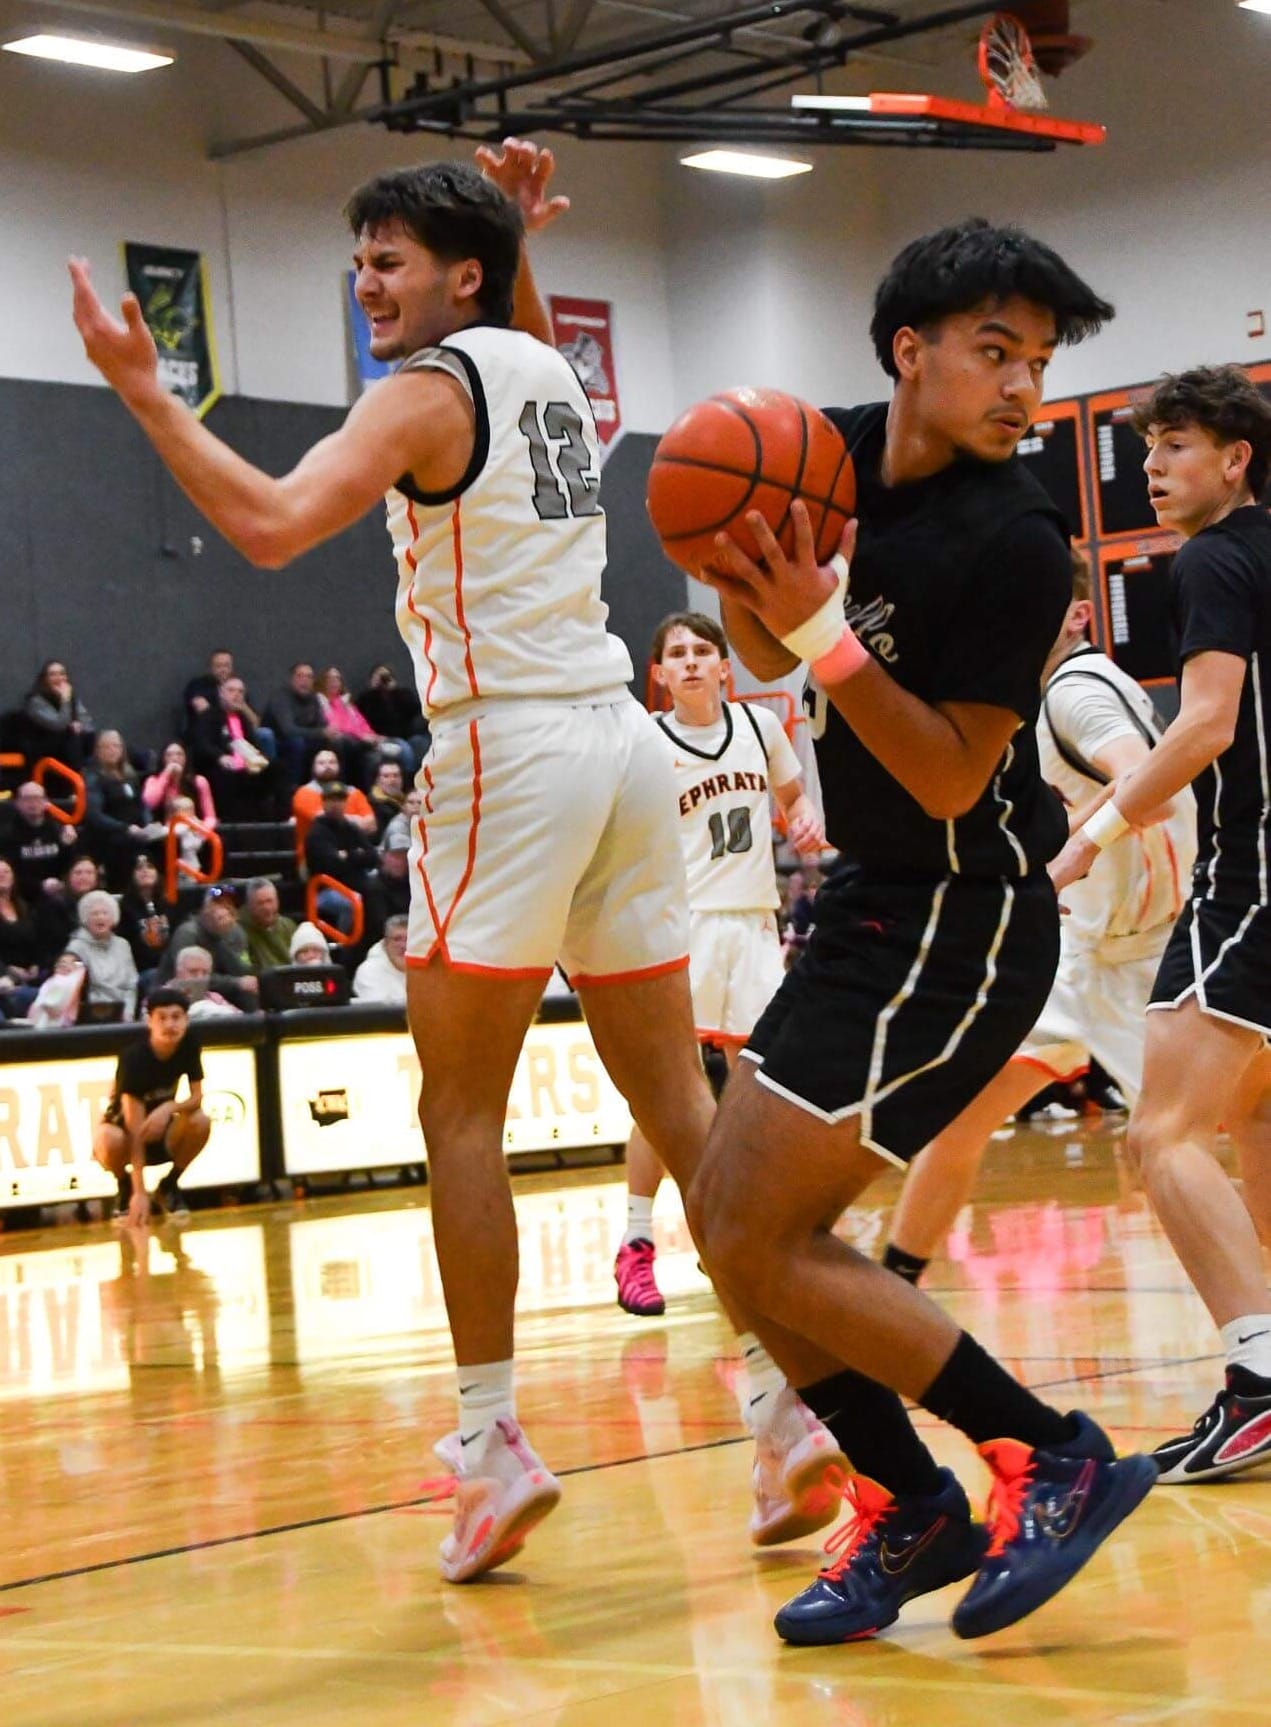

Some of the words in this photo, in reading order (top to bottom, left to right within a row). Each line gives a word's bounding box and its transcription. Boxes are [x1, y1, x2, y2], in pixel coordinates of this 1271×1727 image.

[519, 400, 603, 520] 12
[679, 771, 767, 817] EPHRATA
[708, 806, 752, 861] 10
[294, 981, 324, 994] POSS
